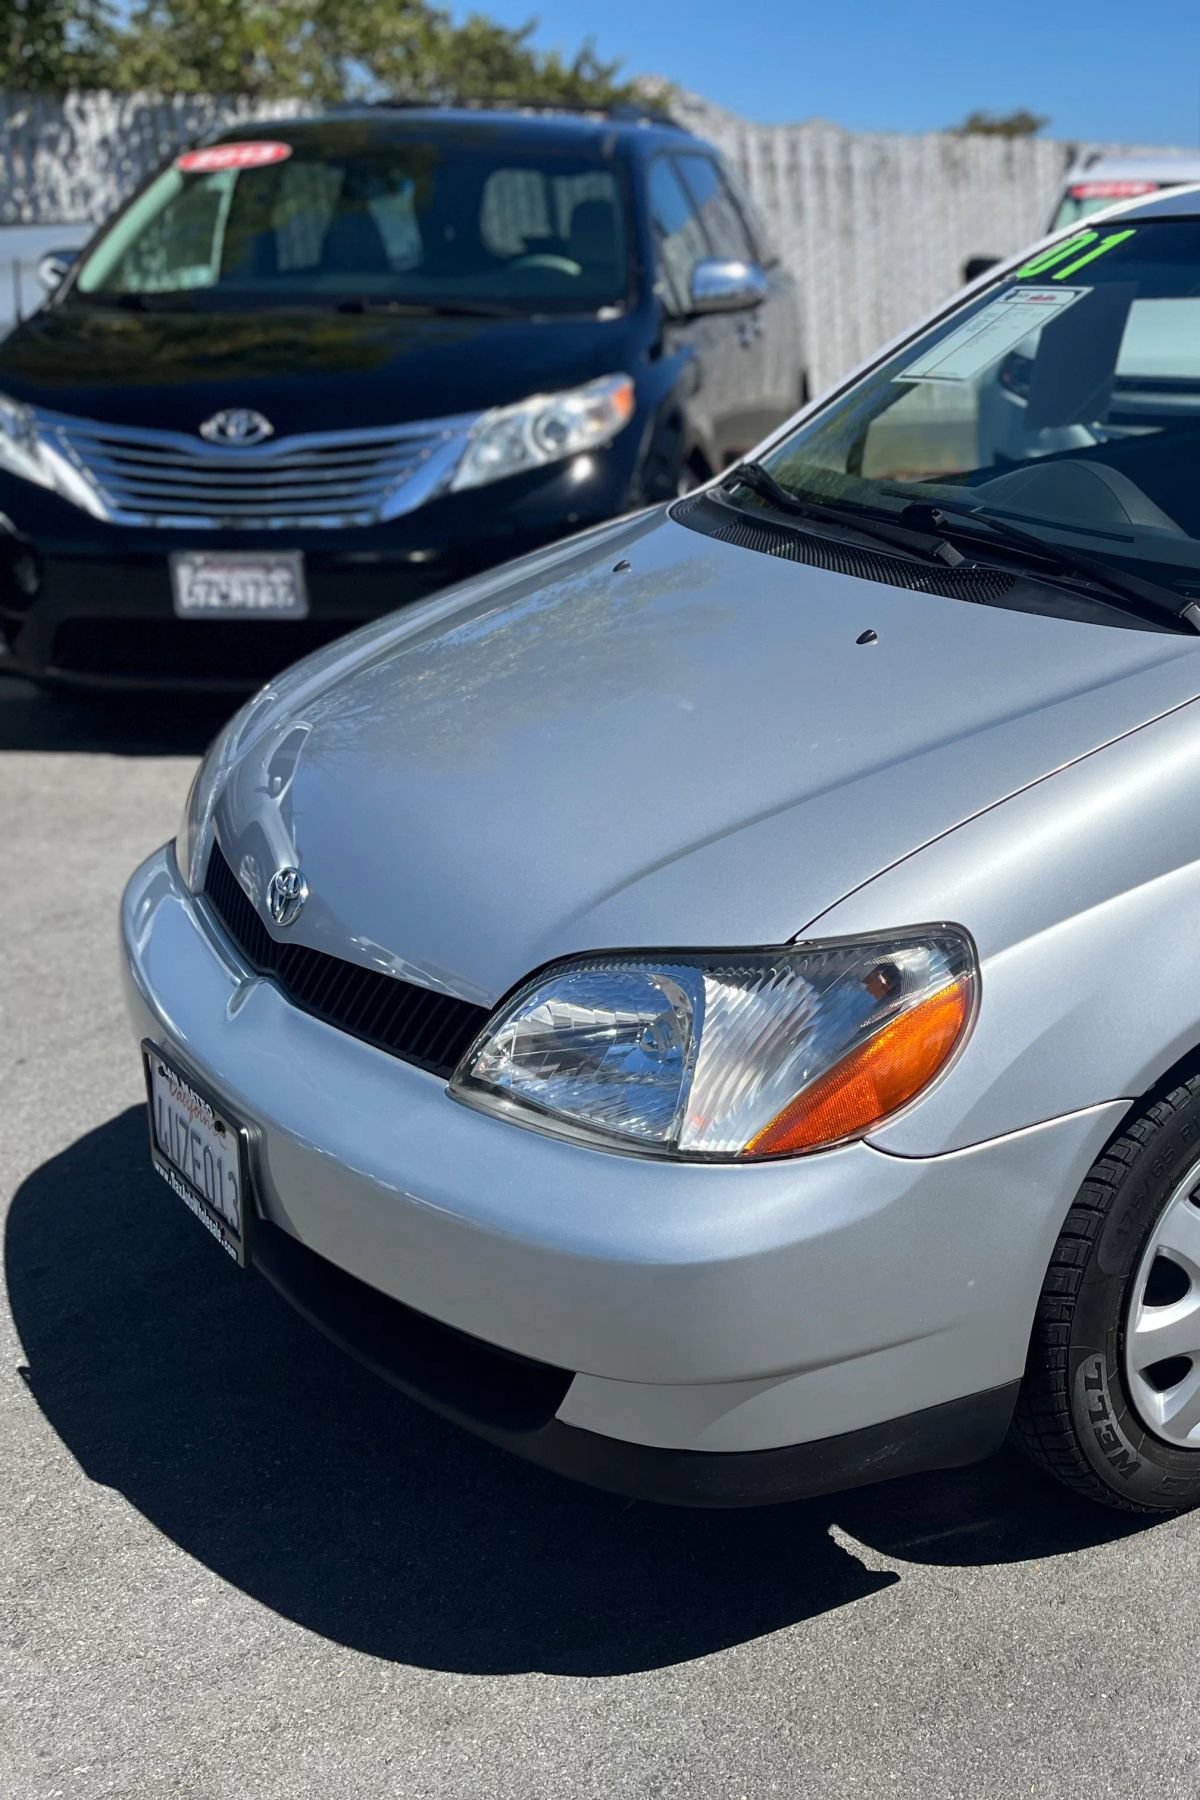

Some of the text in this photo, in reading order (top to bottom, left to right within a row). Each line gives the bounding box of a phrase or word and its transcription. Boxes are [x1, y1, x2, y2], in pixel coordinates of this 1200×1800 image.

[1015, 229, 1137, 280] 01
[157, 1095, 241, 1232] 4UZE013
[1084, 1361, 1143, 1481] WELL
